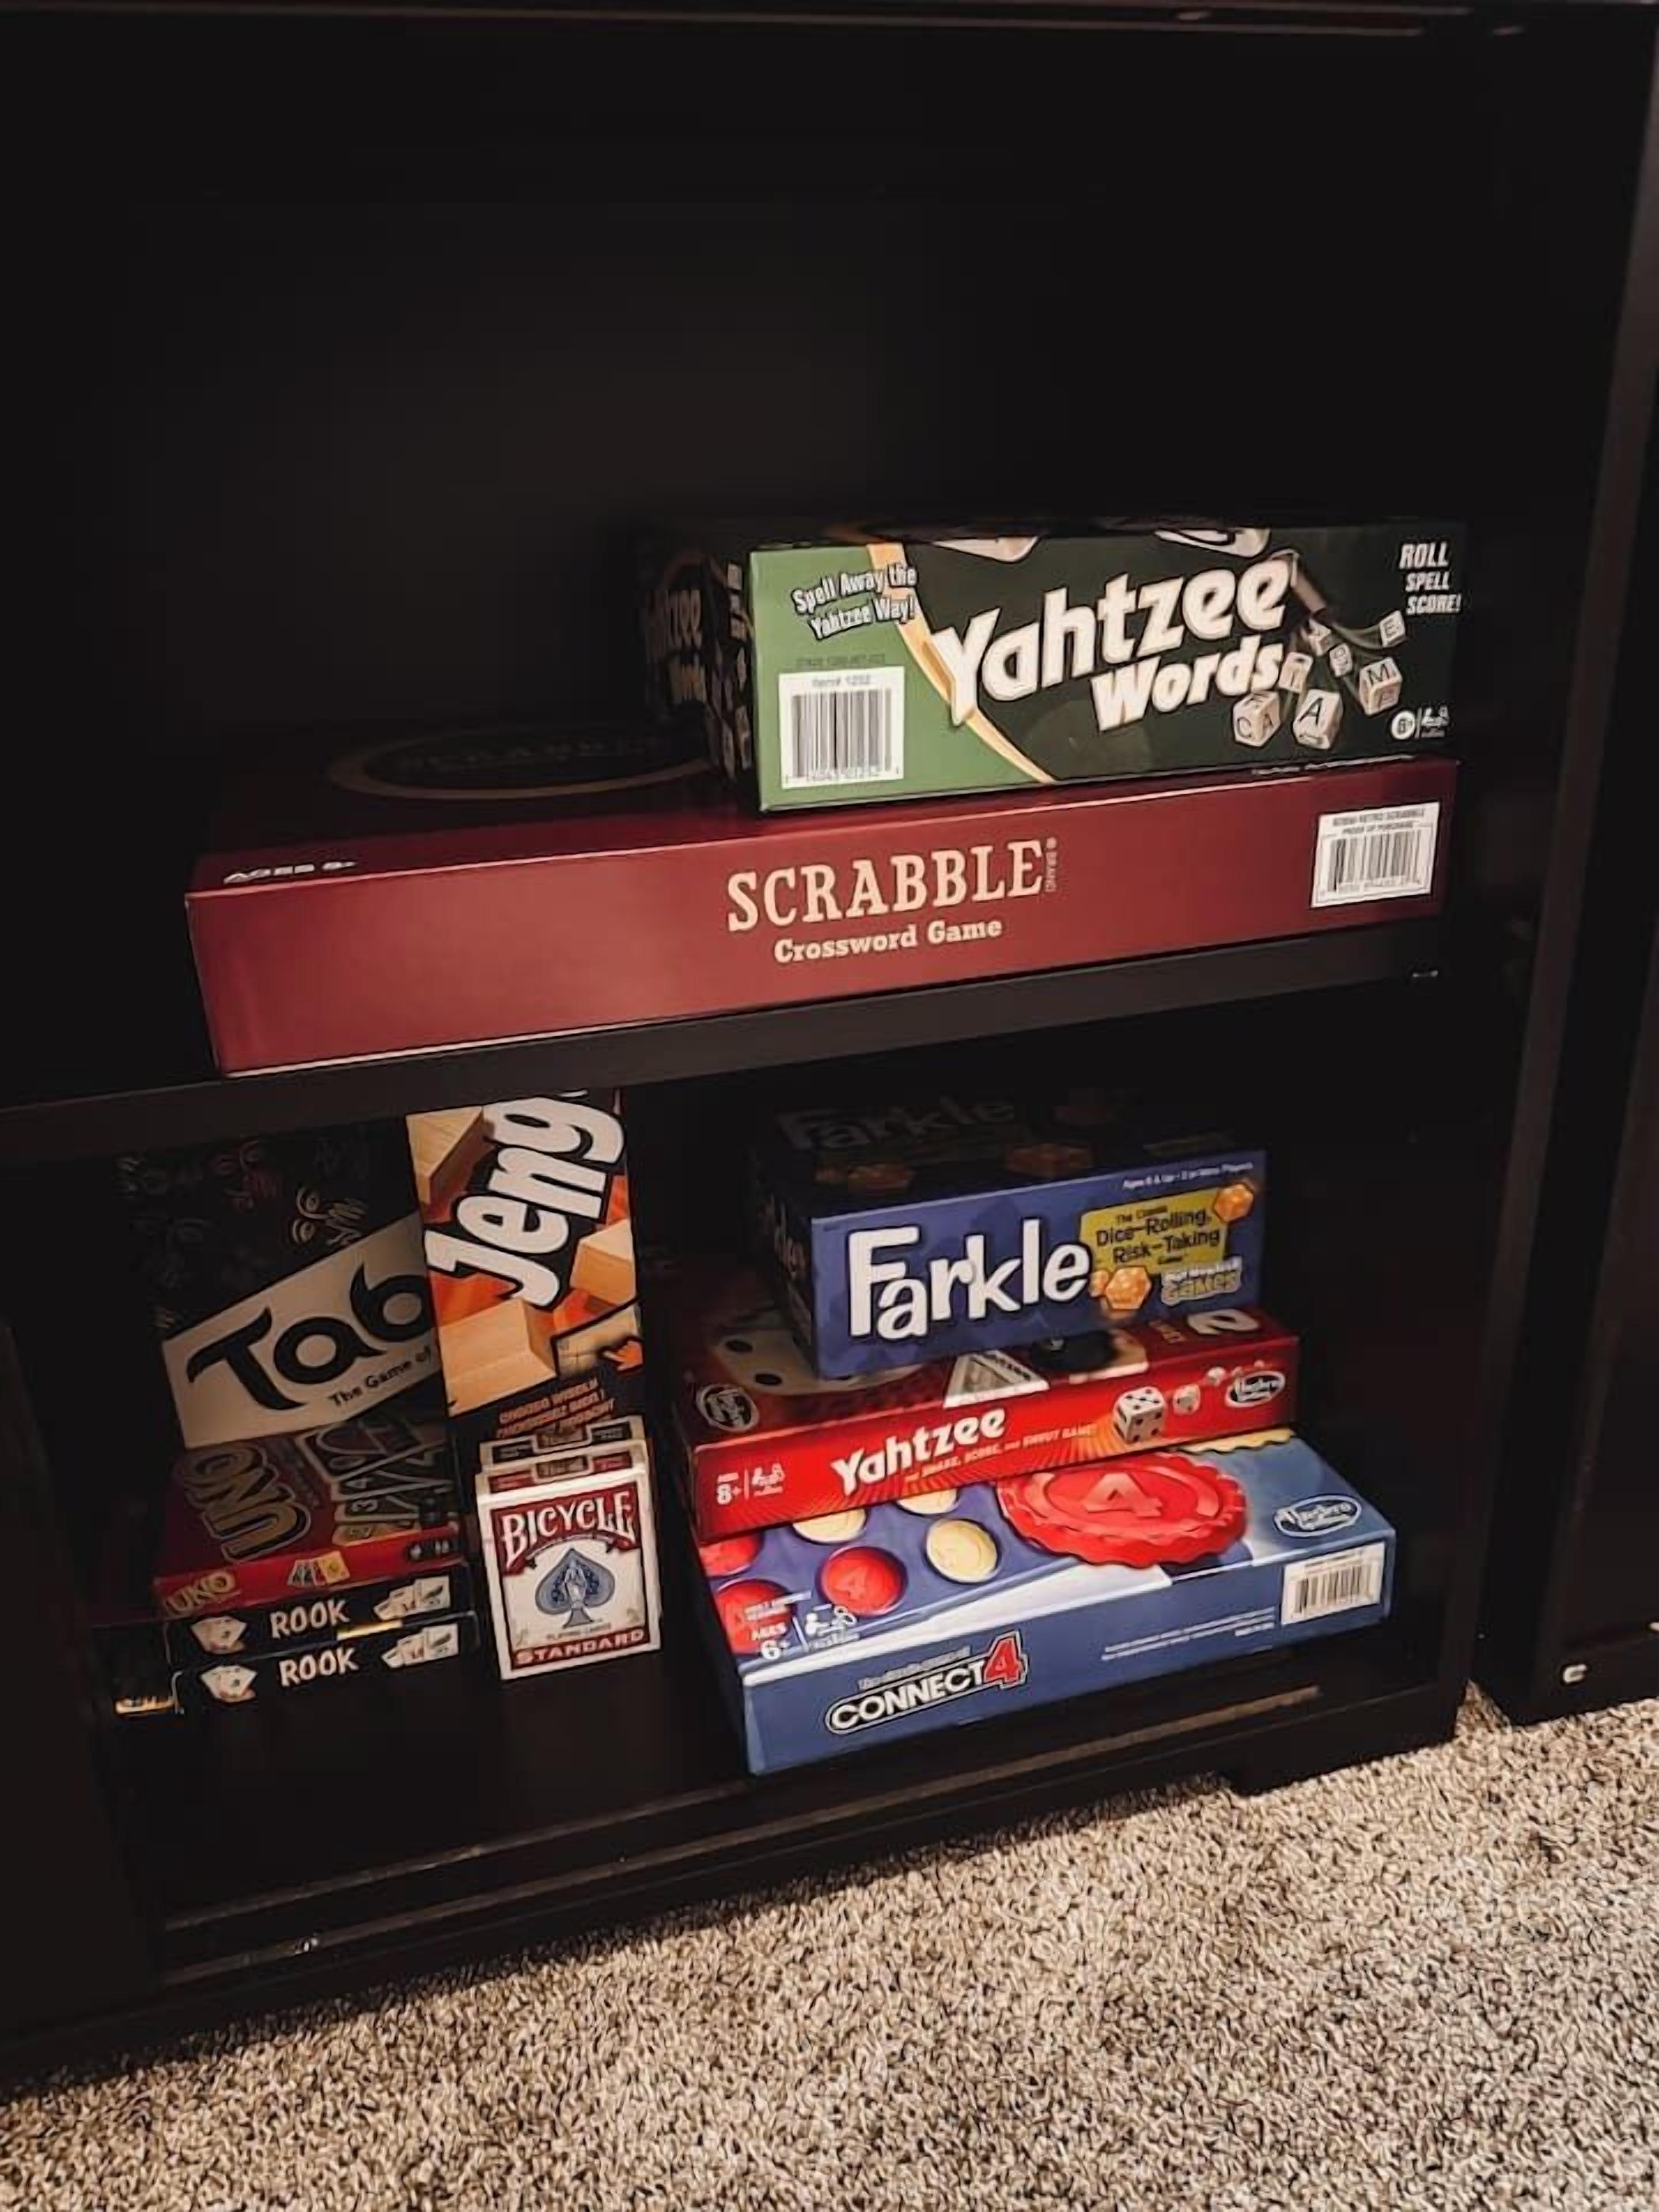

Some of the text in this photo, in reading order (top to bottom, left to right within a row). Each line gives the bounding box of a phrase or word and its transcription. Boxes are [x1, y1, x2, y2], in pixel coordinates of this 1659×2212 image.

[1399, 542, 1449, 569] ROLL
[791, 575, 836, 615] Spell
[839, 570, 884, 596] Away
[1406, 571, 1450, 592] SPELL
[1406, 593, 1461, 615] SCORE!
[930, 556, 1291, 726] Yahtzee
[1093, 635, 1283, 732] Words
[1299, 698, 1324, 725] A
[728, 838, 1043, 931] SCRABBLE
[774, 921, 1003, 963] Crossword Game
[425, 1090, 625, 1306] Jeng
[847, 1217, 1092, 1340] Farkle
[365, 1361, 411, 1388] Game
[830, 1408, 1006, 1496] Yahtzee
[717, 1483, 742, 1505] 8+
[501, 1490, 637, 1571] BICYCLE
[165, 1569, 237, 1612] UNO
[270, 1599, 350, 1639] ROOK
[278, 1646, 359, 1688] ROOK
[516, 1628, 644, 1664] STANDARD
[760, 1639, 790, 1660] 6+
[831, 1659, 986, 1729] CONNECT
[983, 1635, 1023, 1685] 4
